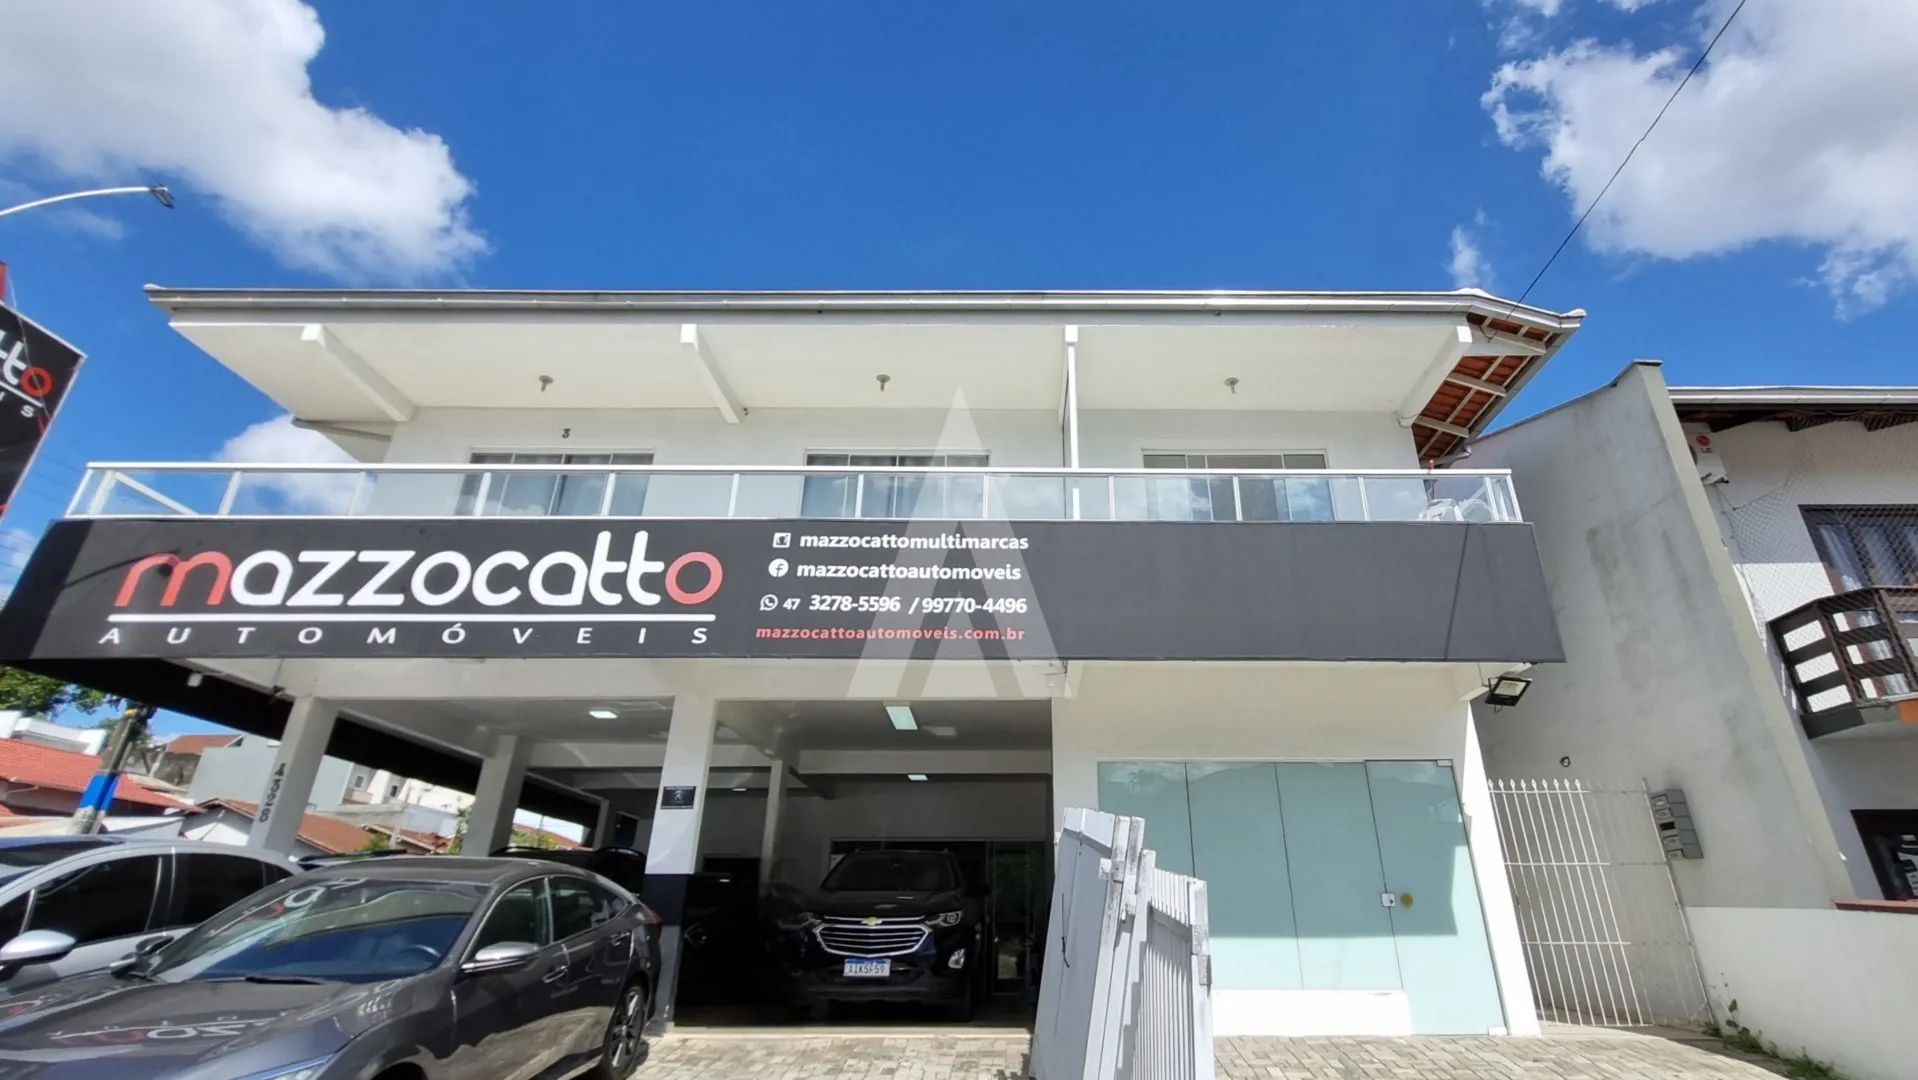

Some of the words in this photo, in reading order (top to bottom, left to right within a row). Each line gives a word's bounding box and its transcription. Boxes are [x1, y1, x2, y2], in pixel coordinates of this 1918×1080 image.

[799, 532, 1030, 551] mazzocattomultimarcas
[112, 530, 724, 607] mazzocatto
[796, 562, 1022, 581] mazzocattoautomoveis
[782, 597, 801, 610] 47
[809, 595, 901, 613] 3278-5596
[98, 622, 708, 645] AUTOMÓVEIS
[756, 626, 1026, 640] mazzocattoautomoveis.com.br
